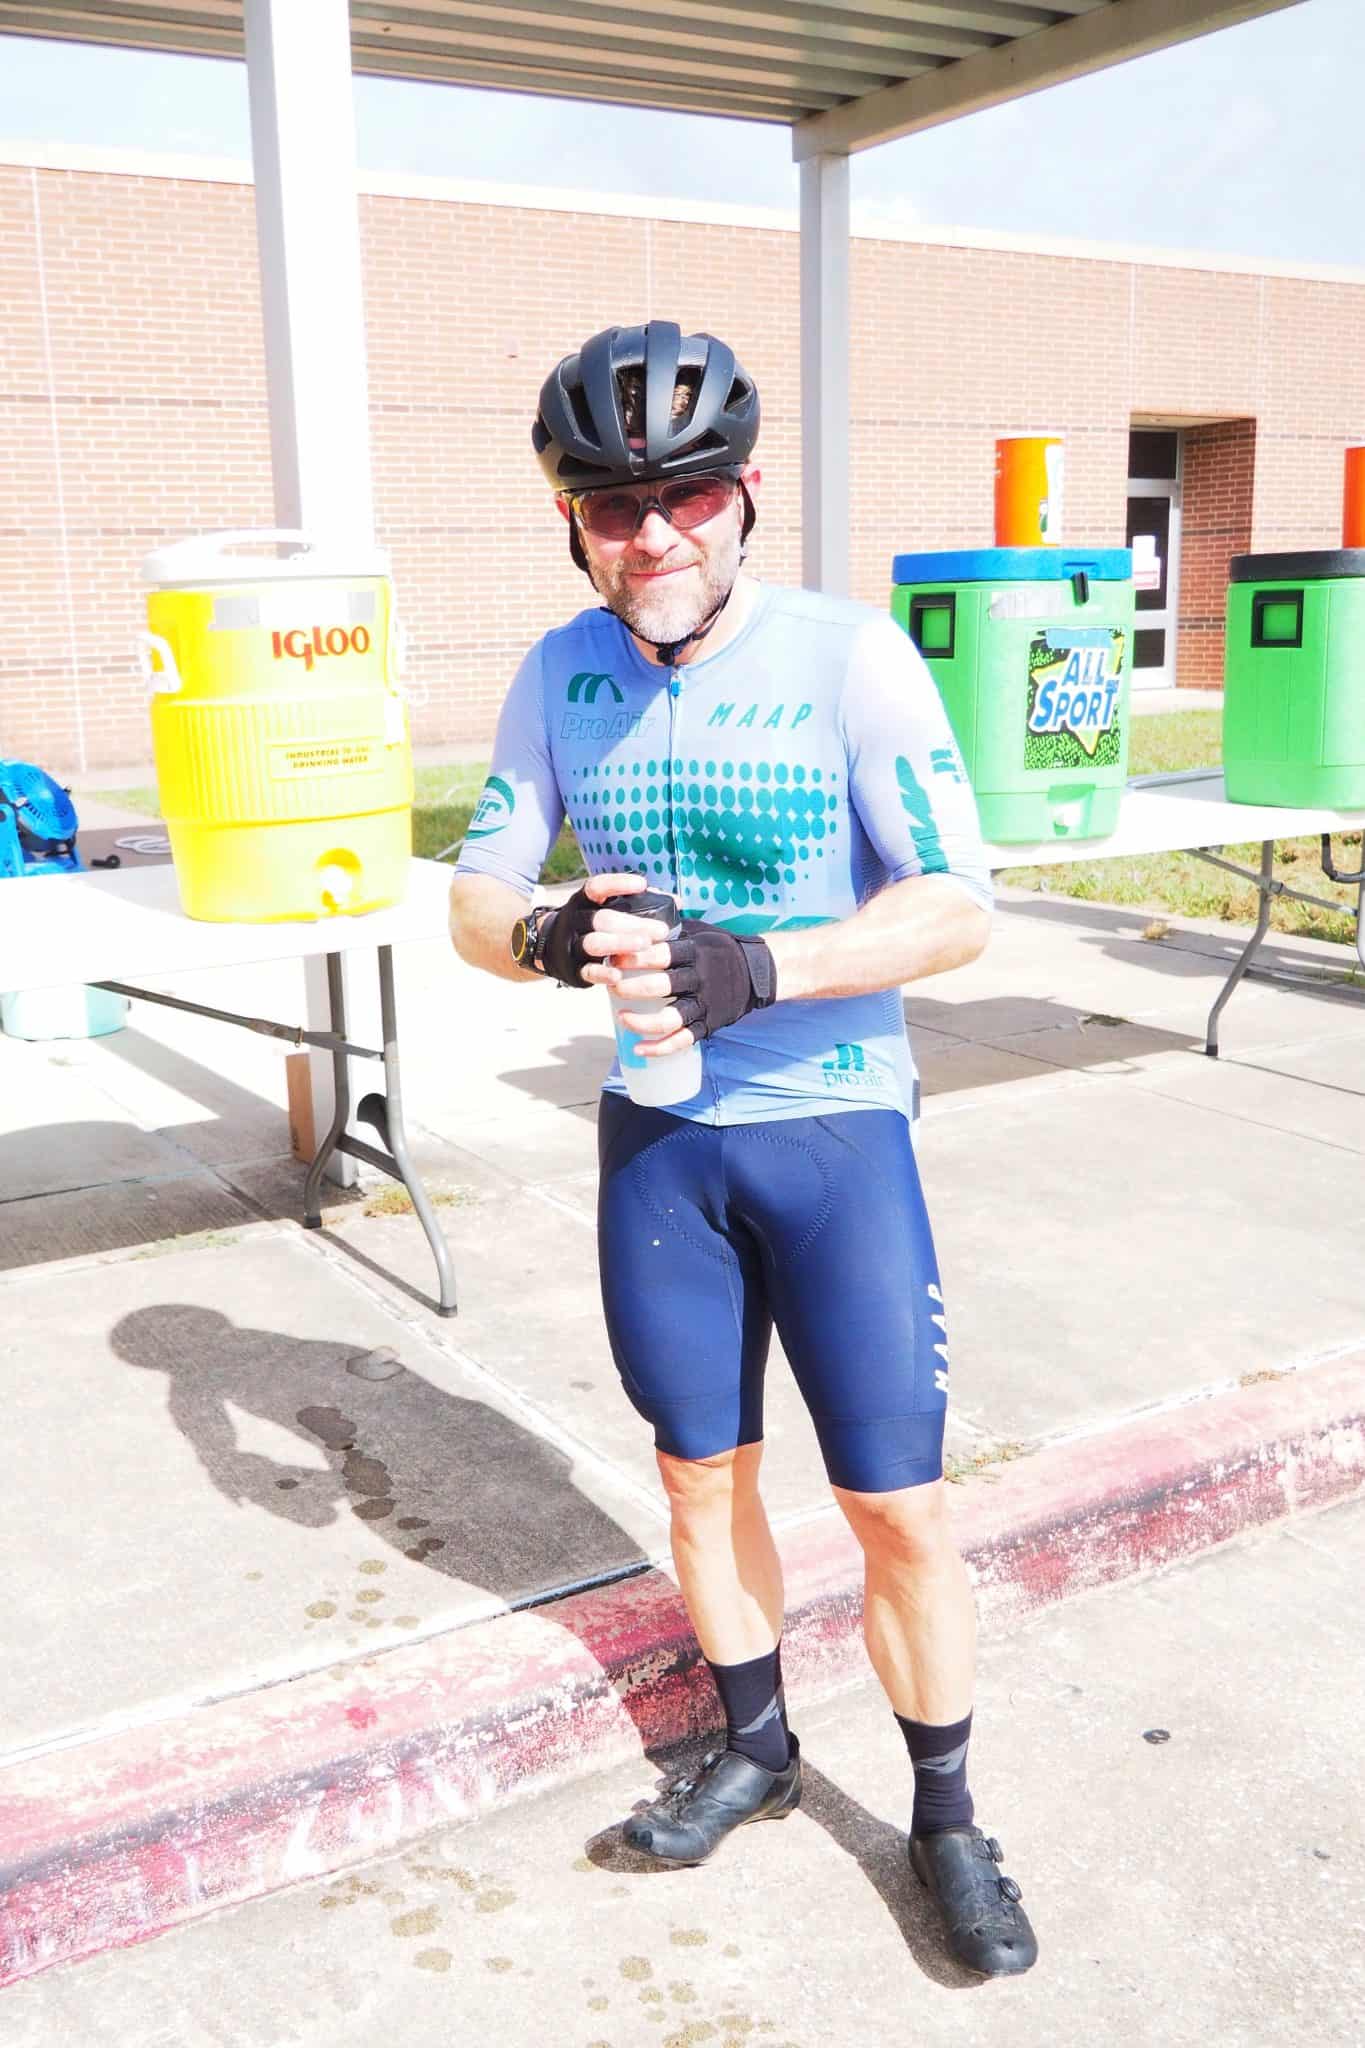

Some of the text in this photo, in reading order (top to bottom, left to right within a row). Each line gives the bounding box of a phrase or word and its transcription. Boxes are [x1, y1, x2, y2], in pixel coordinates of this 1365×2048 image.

[271, 625, 370, 671] IGLOO
[1061, 651, 1105, 686] ALL
[707, 702, 813, 729] MAAP
[1033, 679, 1119, 728] SPORT
[560, 711, 657, 739] ProAir
